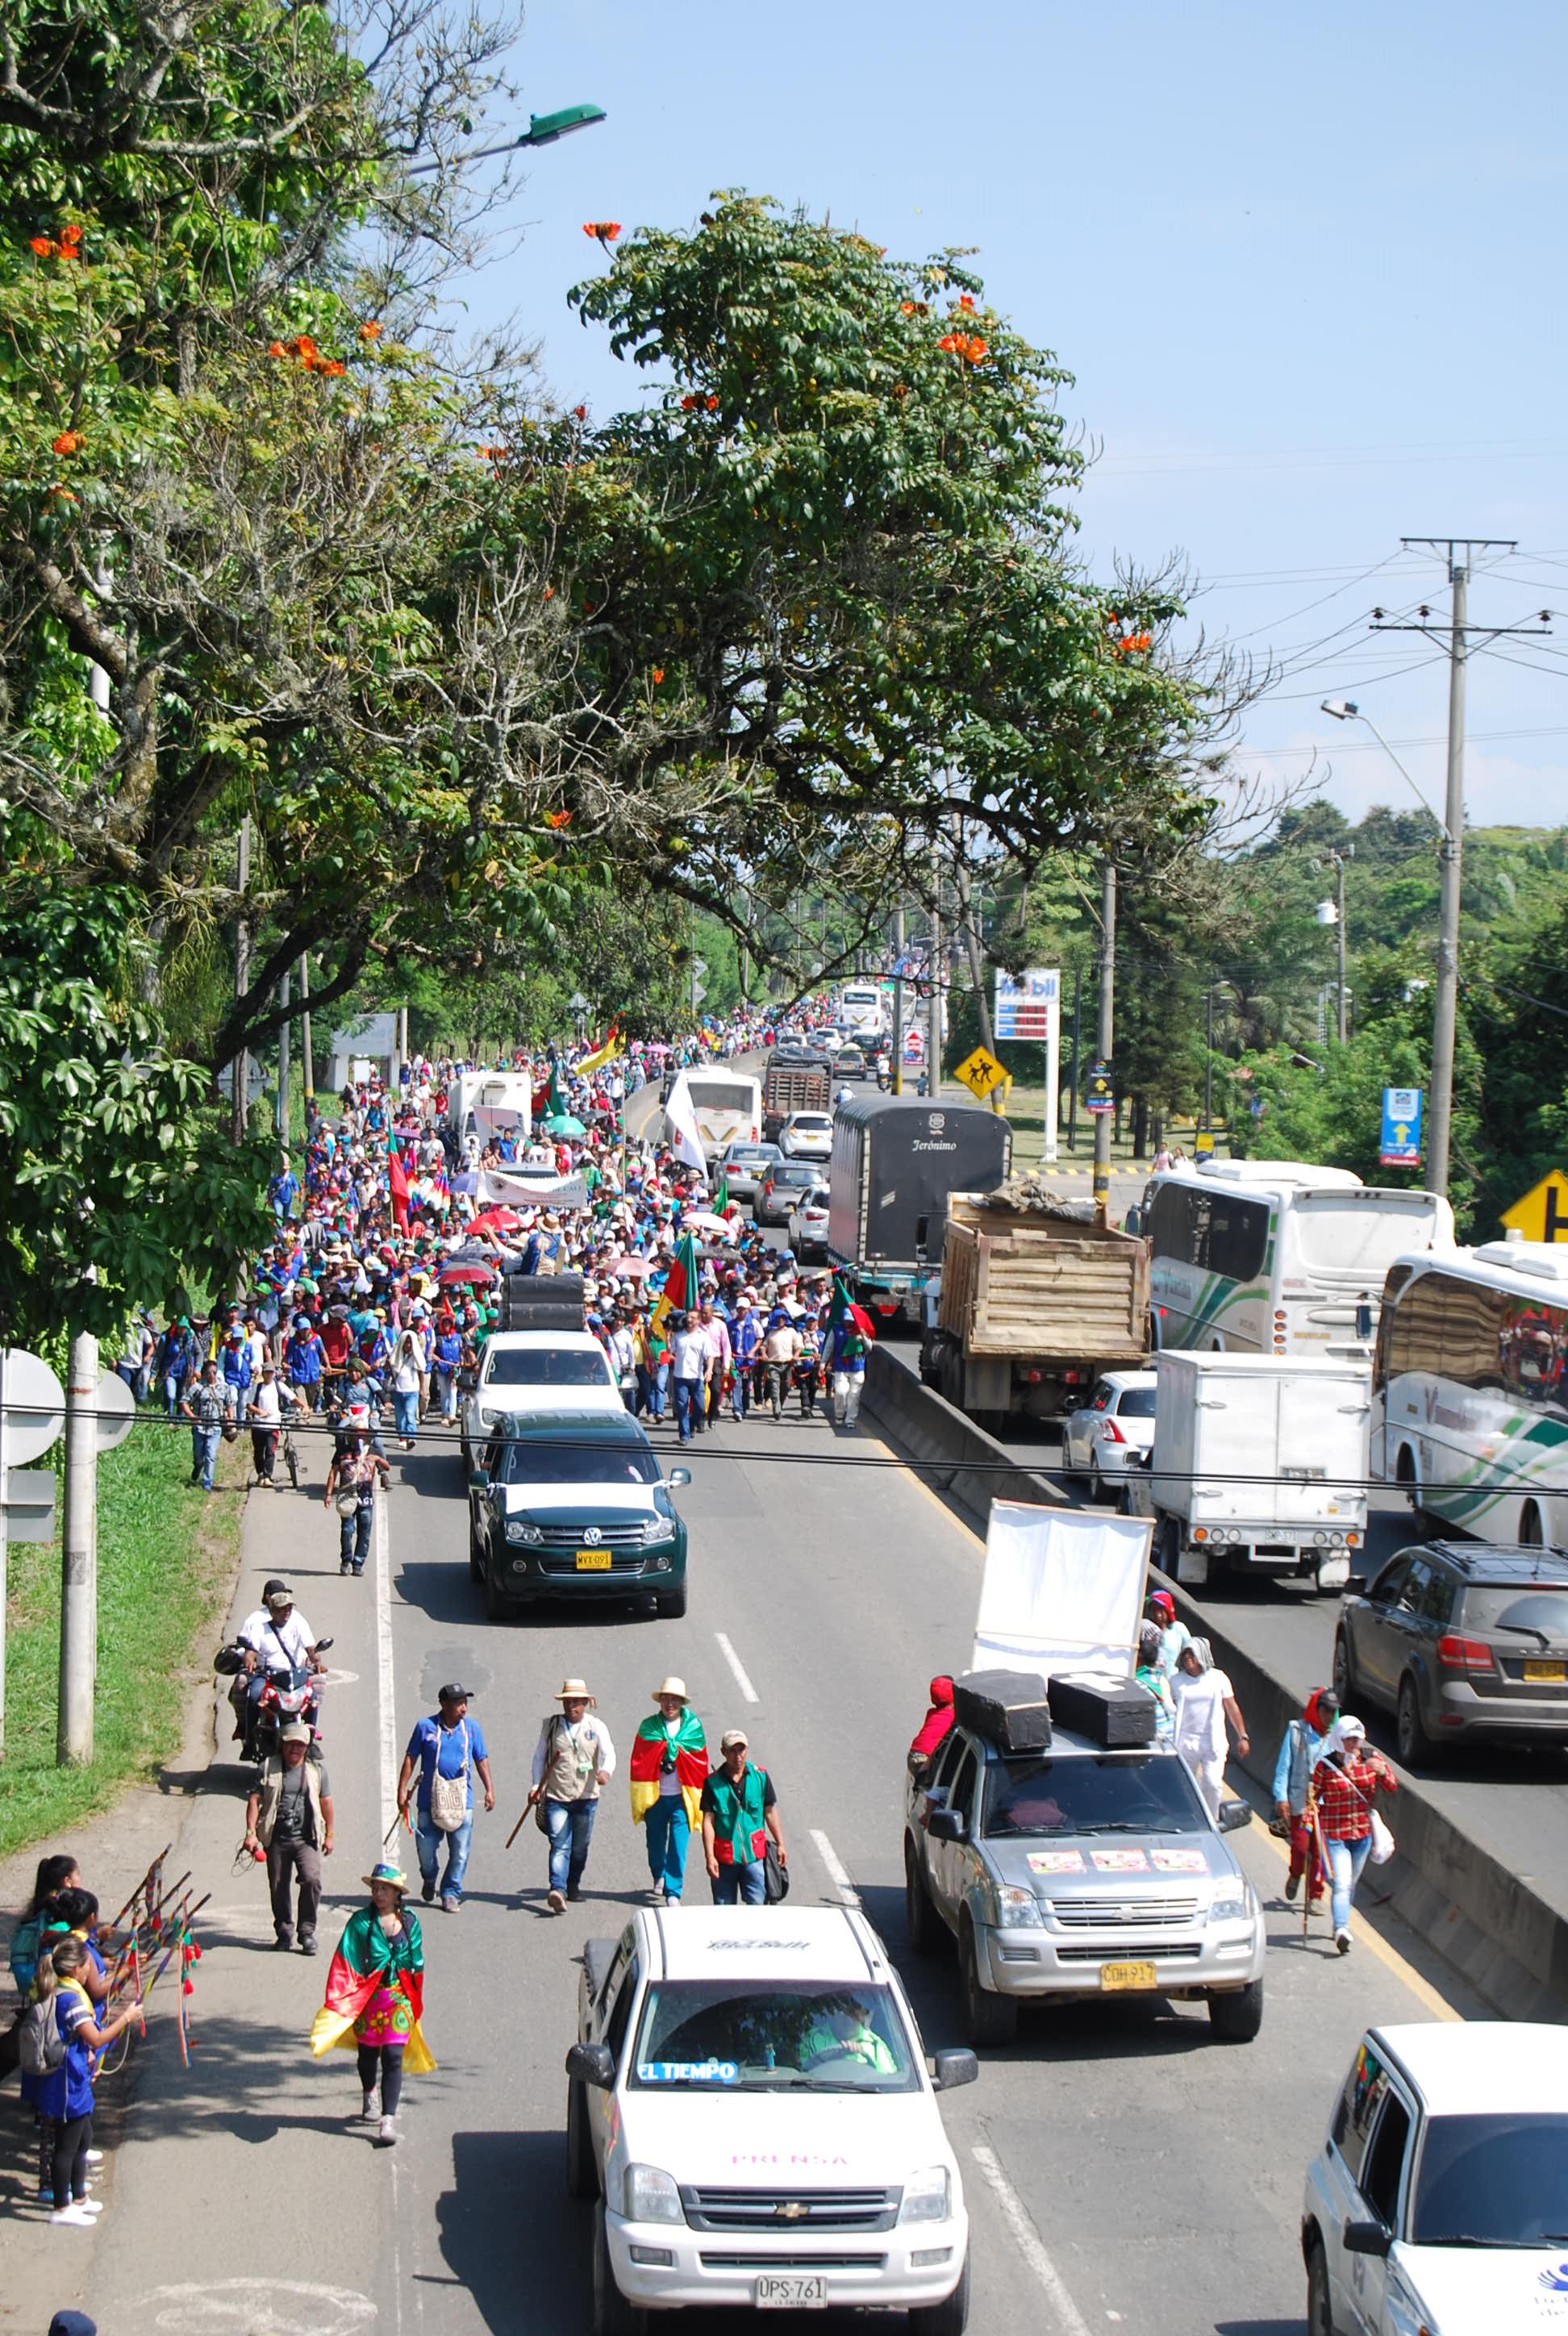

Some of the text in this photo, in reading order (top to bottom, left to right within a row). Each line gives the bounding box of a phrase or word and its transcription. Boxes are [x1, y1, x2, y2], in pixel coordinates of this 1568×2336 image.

[912, 1140, 957, 1151] Jerónimo
[638, 2063, 736, 2079] EL TIEMPO
